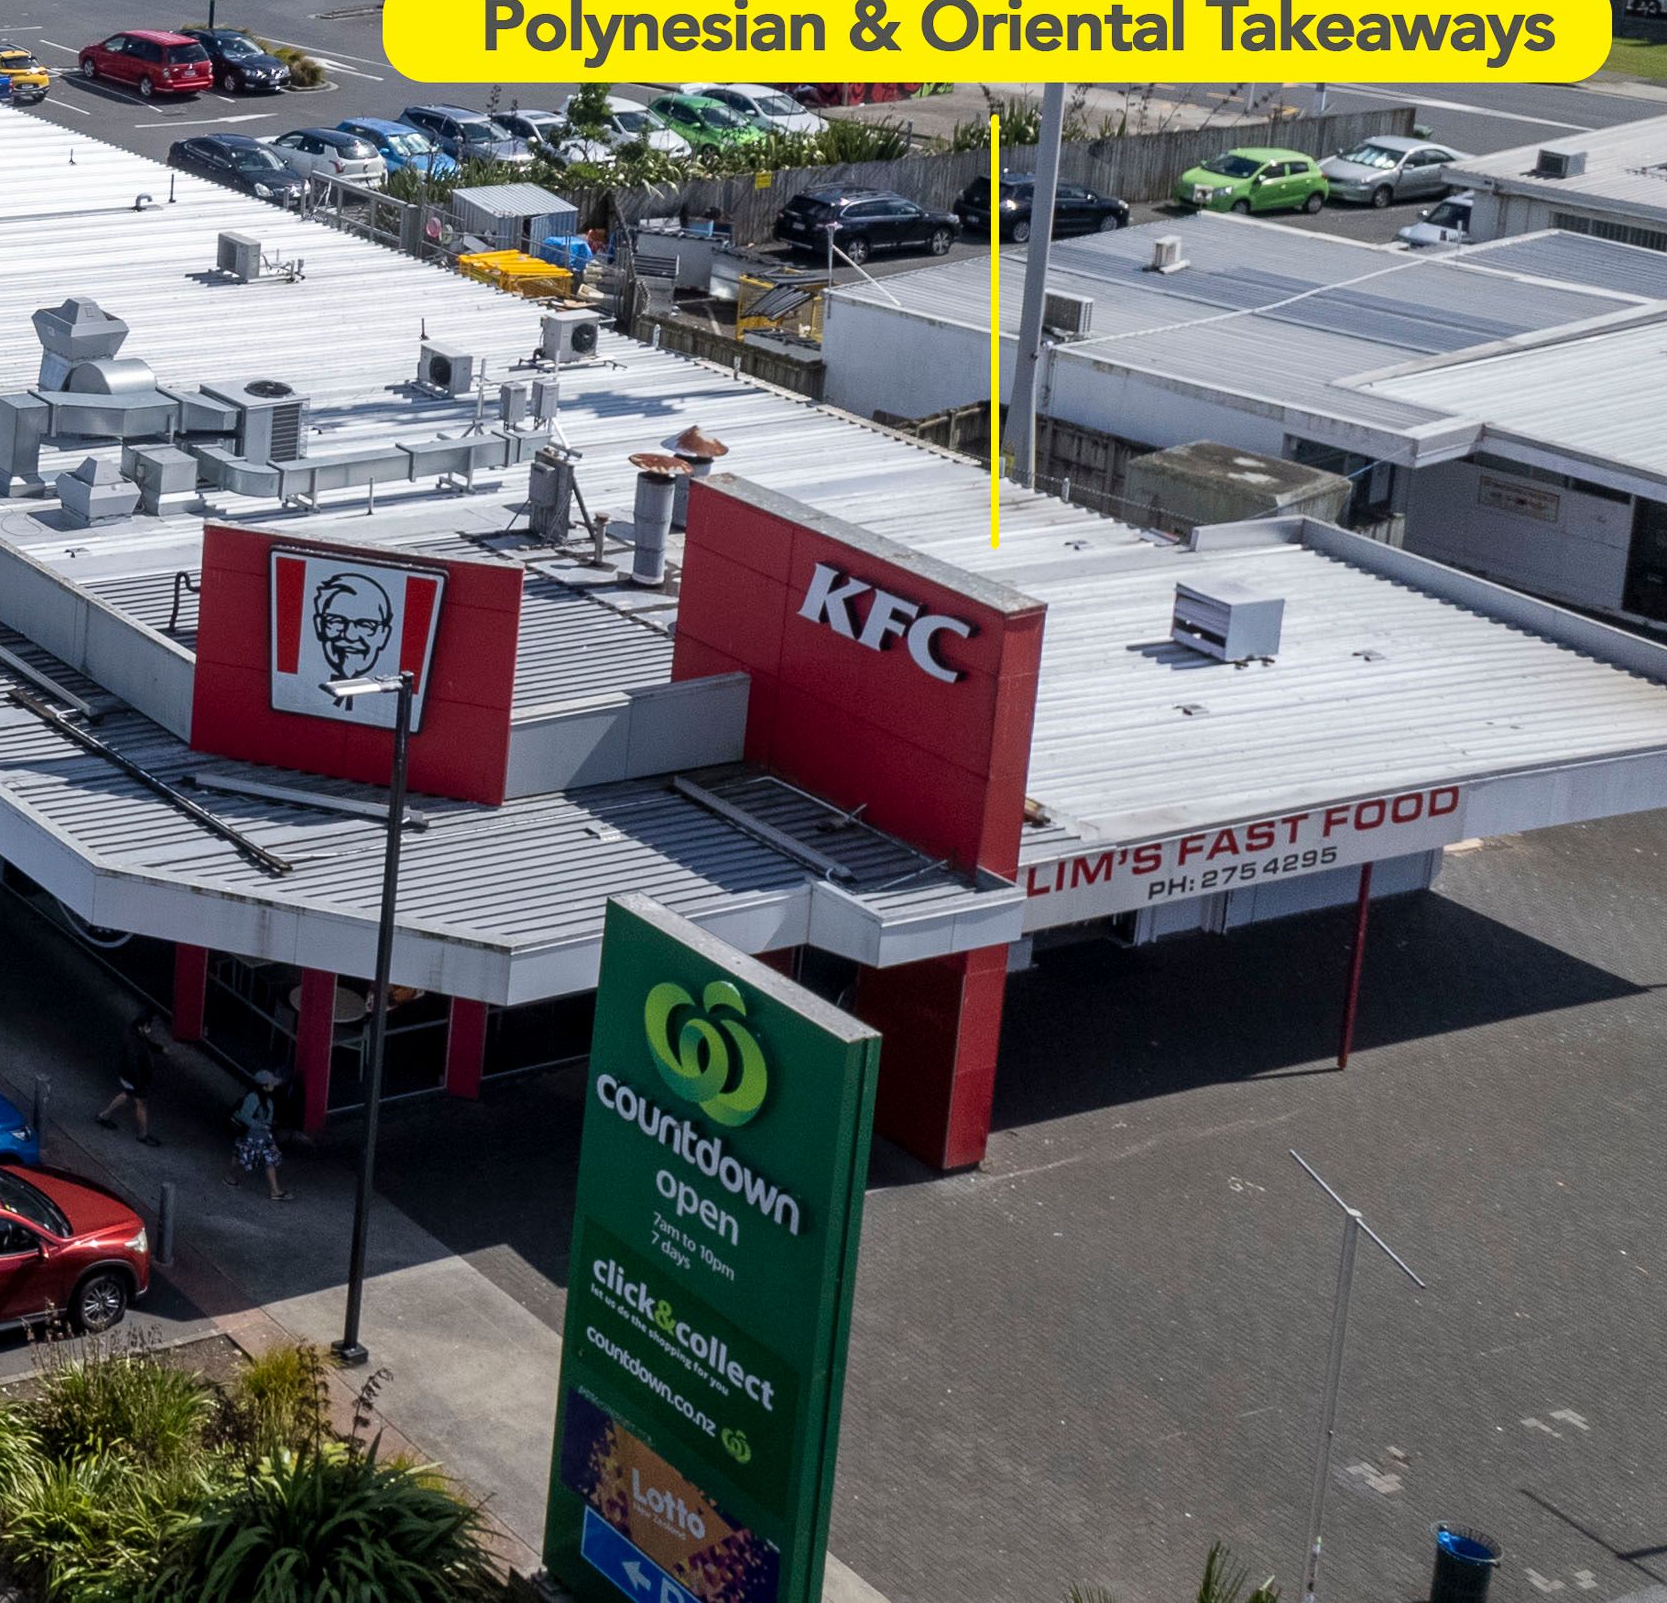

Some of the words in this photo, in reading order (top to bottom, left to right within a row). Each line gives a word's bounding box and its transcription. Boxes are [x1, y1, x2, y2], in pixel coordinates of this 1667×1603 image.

[798, 562, 973, 682] KFC
[1027, 841, 1162, 896] LIM'S
[1178, 813, 1309, 865] FAST
[1323, 785, 1460, 837] FOOD
[1147, 876, 1195, 899] PH:
[1201, 864, 1256, 888] 275
[1262, 846, 1337, 875] 4295
[596, 1074, 799, 1236] countdown
[651, 1231, 660, 1245] 7
[661, 1240, 691, 1269] days
[653, 1211, 680, 1241] 7am
[682, 1233, 696, 1252] to
[700, 1245, 735, 1282] 10pm
[656, 1170, 739, 1246] open
[586, 1326, 717, 1437] countdown.co.nz
[591, 1283, 603, 1300] let
[605, 1296, 616, 1309] us
[617, 1305, 629, 1319] do
[631, 1314, 647, 1333] the
[649, 1328, 692, 1371] shopping
[693, 1361, 709, 1380] for
[710, 1376, 729, 1396] you
[632, 1467, 706, 1540] Lotto
